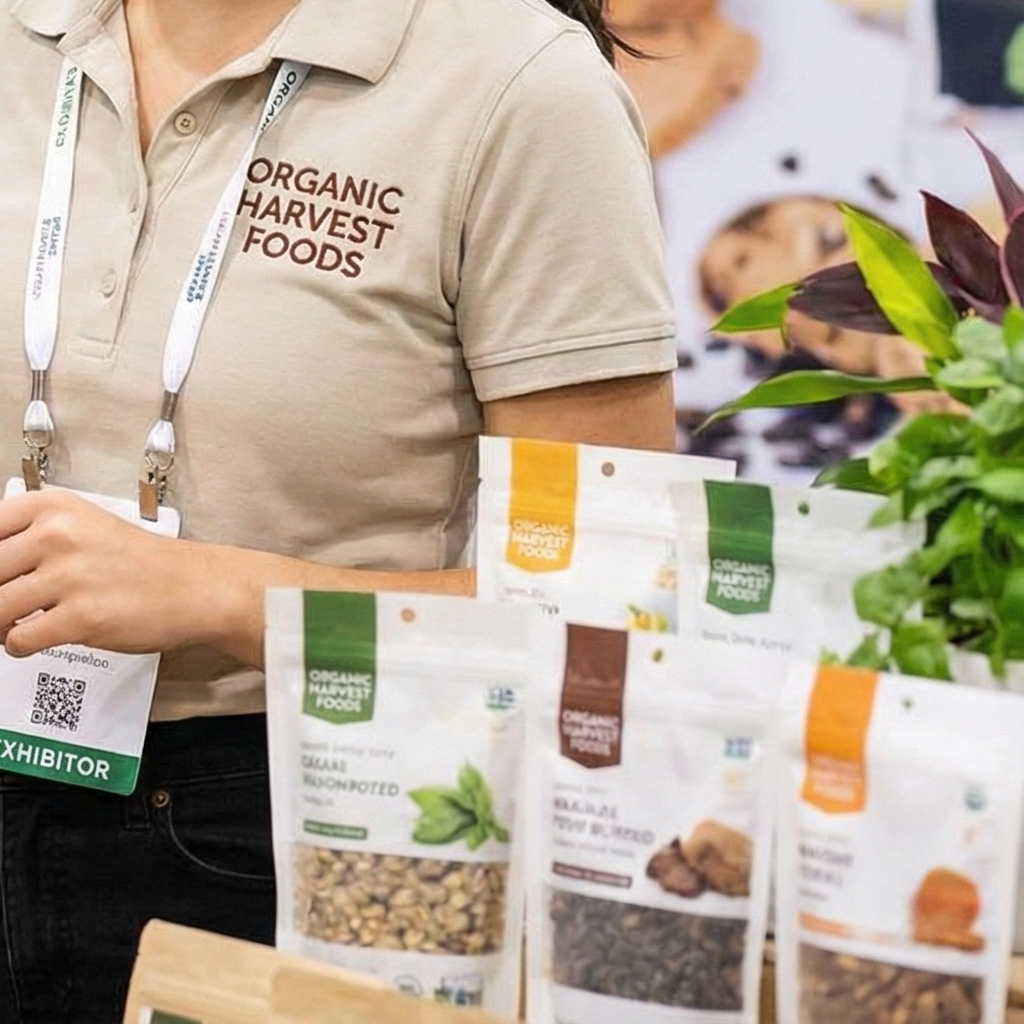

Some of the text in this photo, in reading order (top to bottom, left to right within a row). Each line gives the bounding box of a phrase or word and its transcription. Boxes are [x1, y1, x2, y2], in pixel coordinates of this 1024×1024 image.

[246, 157, 404, 215] ORGANIC
[236, 189, 395, 250] HARVEST
[242, 225, 365, 278] FOODS
